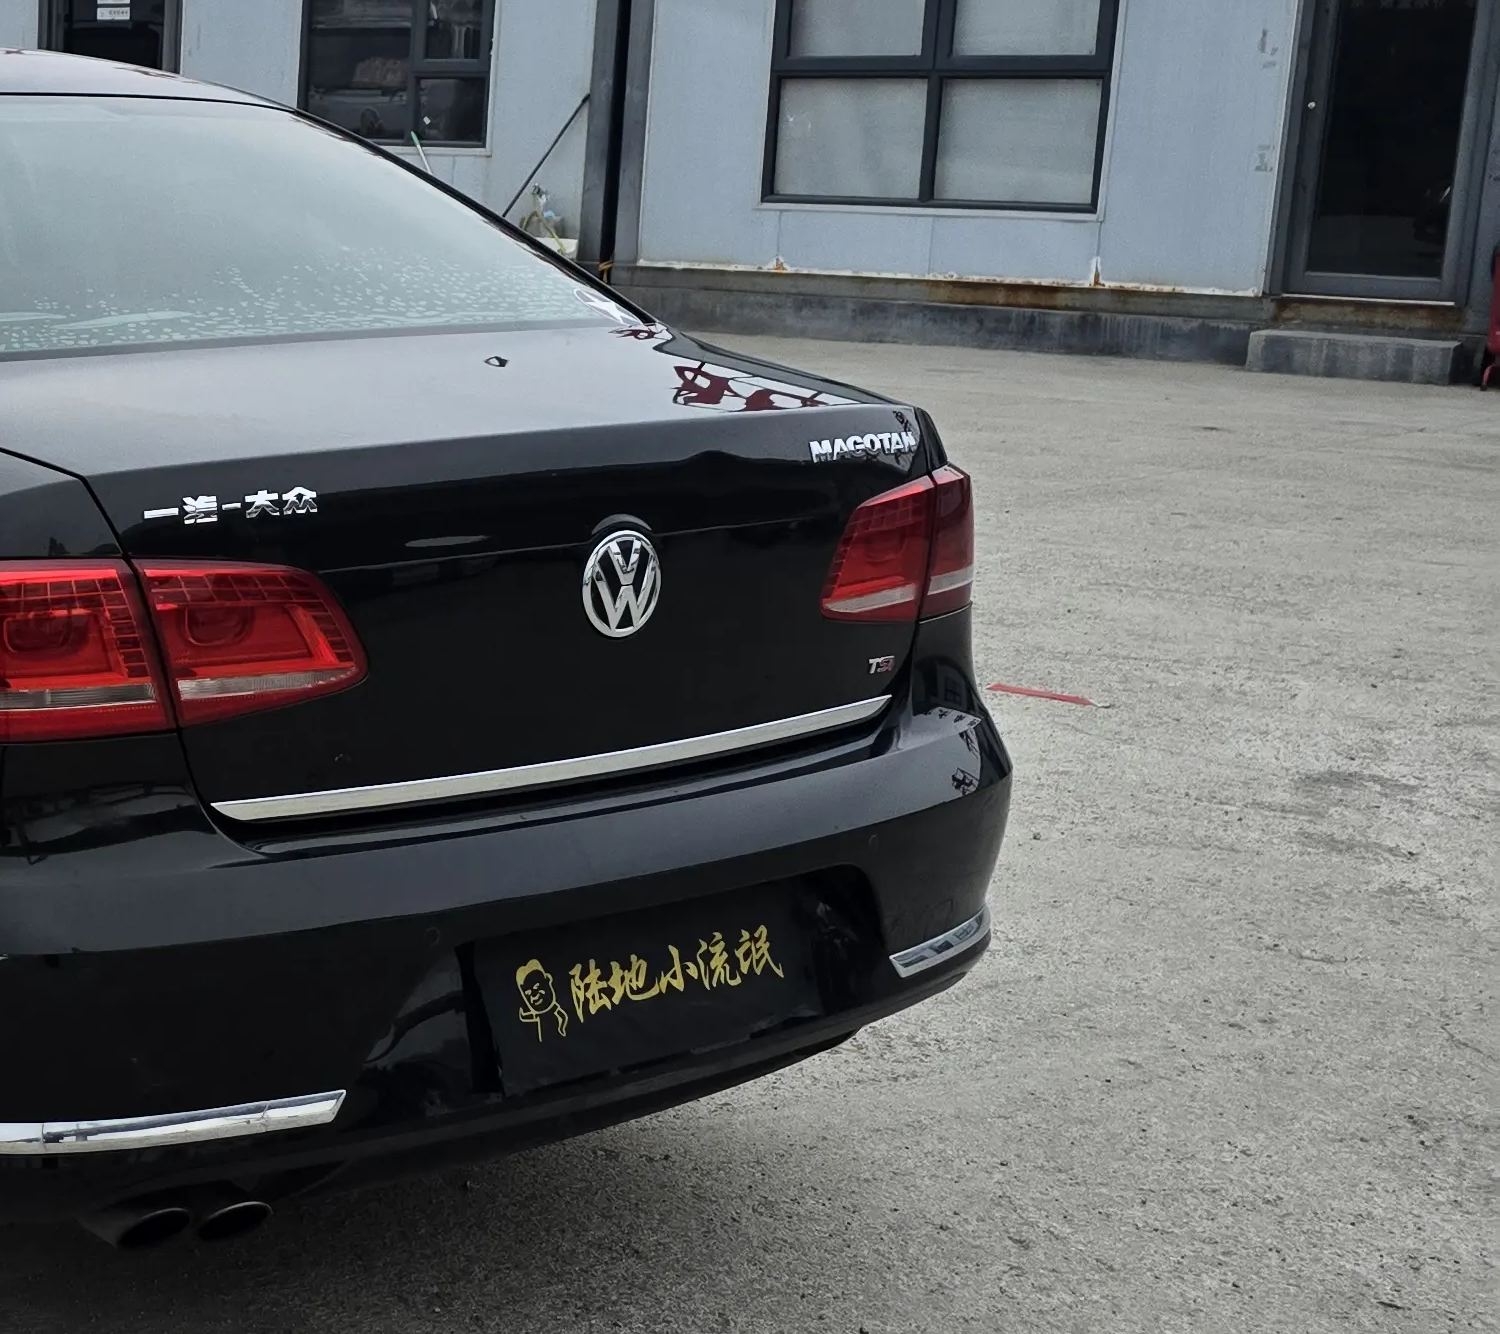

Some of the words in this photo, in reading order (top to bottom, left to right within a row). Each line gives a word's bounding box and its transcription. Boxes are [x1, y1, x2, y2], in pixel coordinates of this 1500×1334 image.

[809, 431, 917, 464] MAGOTAN
[143, 486, 318, 524] 一汽-大众
[569, 924, 785, 1023] 陆地小流氓
